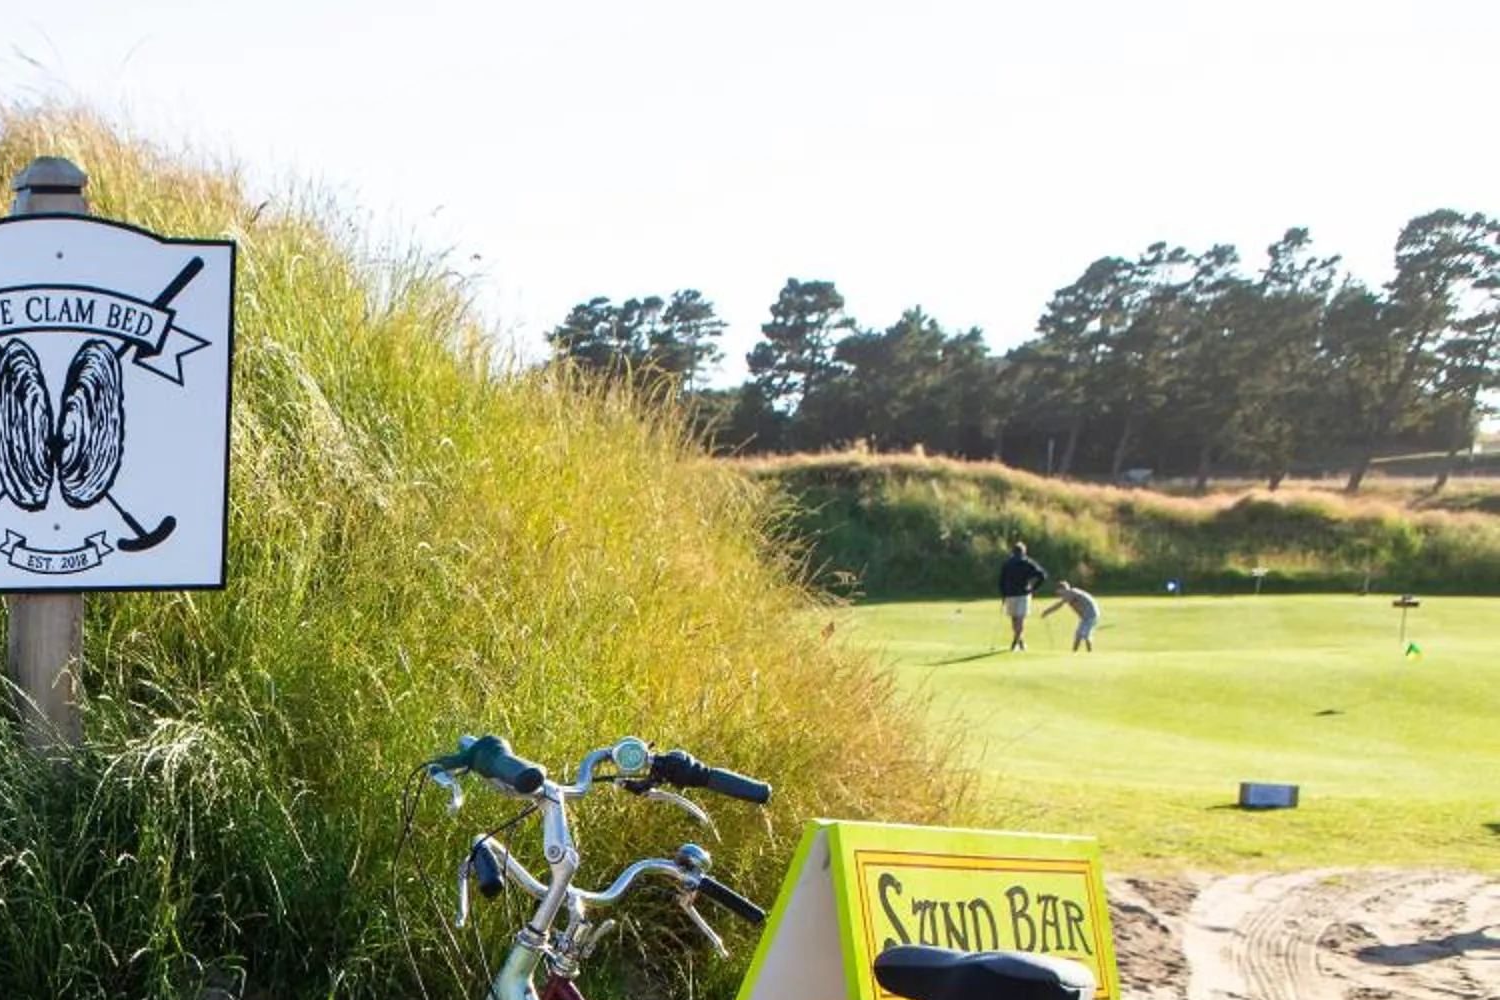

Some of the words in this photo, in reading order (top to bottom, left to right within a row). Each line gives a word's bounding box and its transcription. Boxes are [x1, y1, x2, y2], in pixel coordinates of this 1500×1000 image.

[25, 296, 96, 324] CLAM
[106, 302, 155, 337] BED
[60, 552, 89, 569] 2018
[877, 872, 999, 951] SAND
[1004, 884, 1093, 956] BAR
